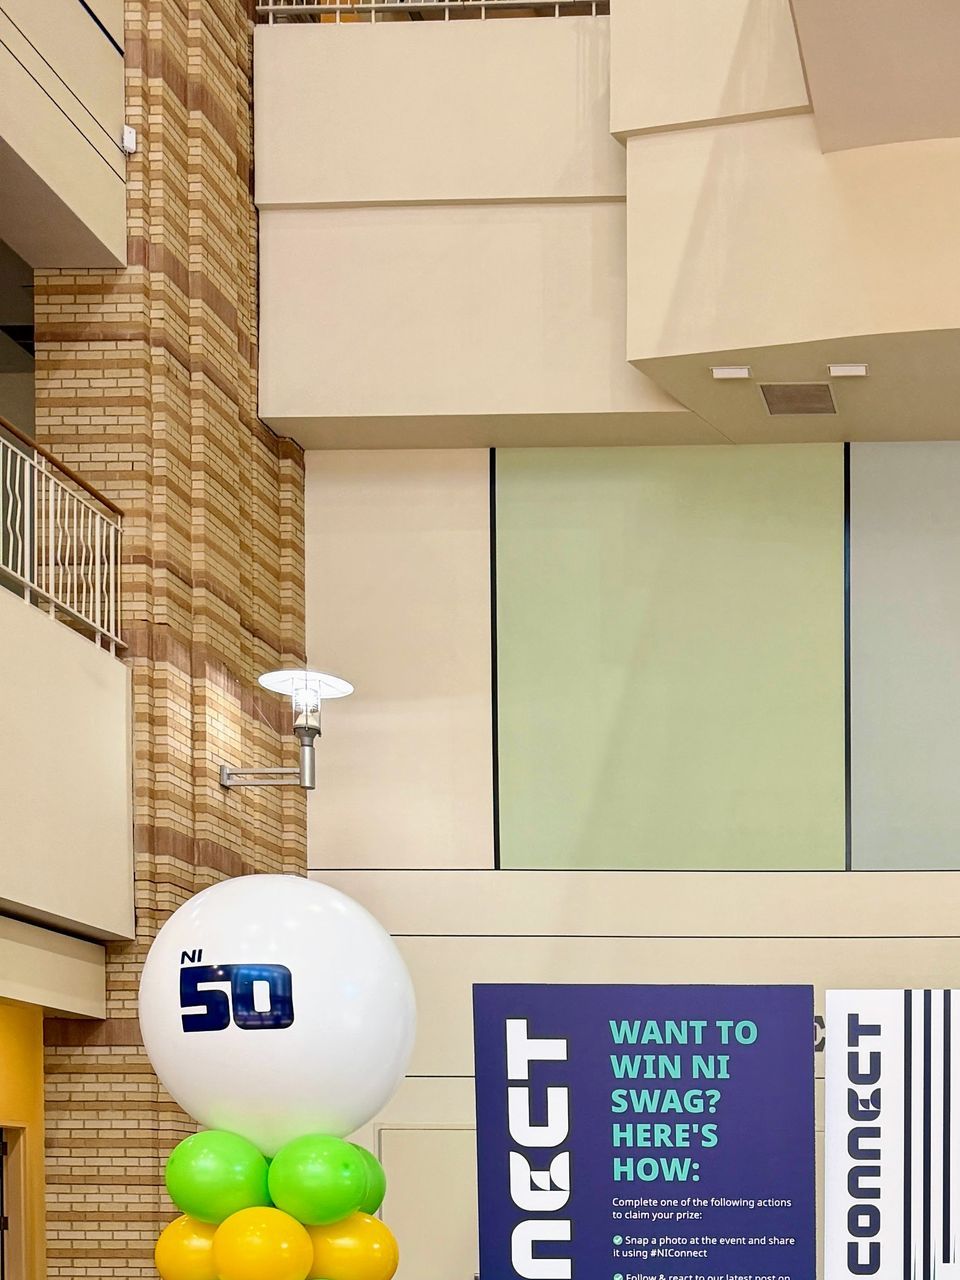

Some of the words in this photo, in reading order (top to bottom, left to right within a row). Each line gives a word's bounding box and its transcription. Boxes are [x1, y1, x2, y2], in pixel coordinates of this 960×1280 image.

[180, 949, 203, 964] NI
[179, 963, 295, 1032] 50
[608, 1020, 708, 1045] WANT
[715, 1020, 758, 1045] TO
[609, 1054, 681, 1079] WIN
[692, 1055, 730, 1079] NI
[611, 1088, 721, 1114] SWAG?
[612, 1123, 718, 1148] HERE'S
[613, 1157, 700, 1182] HOW:
[612, 1197, 659, 1209] Complete
[660, 1199, 679, 1207] one
[680, 1197, 692, 1207] of
[692, 1197, 709, 1207] the
[710, 1197, 755, 1209] following
[756, 1198, 792, 1207] actions
[612, 1211, 623, 1219] to
[624, 1210, 650, 1220] claim
[651, 1212, 675, 1222] your
[676, 1210, 703, 1222] prize:
[625, 1235, 649, 1247] Snap
[650, 1237, 657, 1245] a
[659, 1235, 688, 1247] photo
[689, 1236, 700, 1245] at
[701, 1235, 718, 1245] the
[719, 1237, 746, 1245] event
[747, 1235, 766, 1245] and
[768, 1235, 796, 1245] share
[613, 1248, 620, 1258] it
[621, 1248, 648, 1260] using
[650, 1248, 708, 1258] #NIConnect
